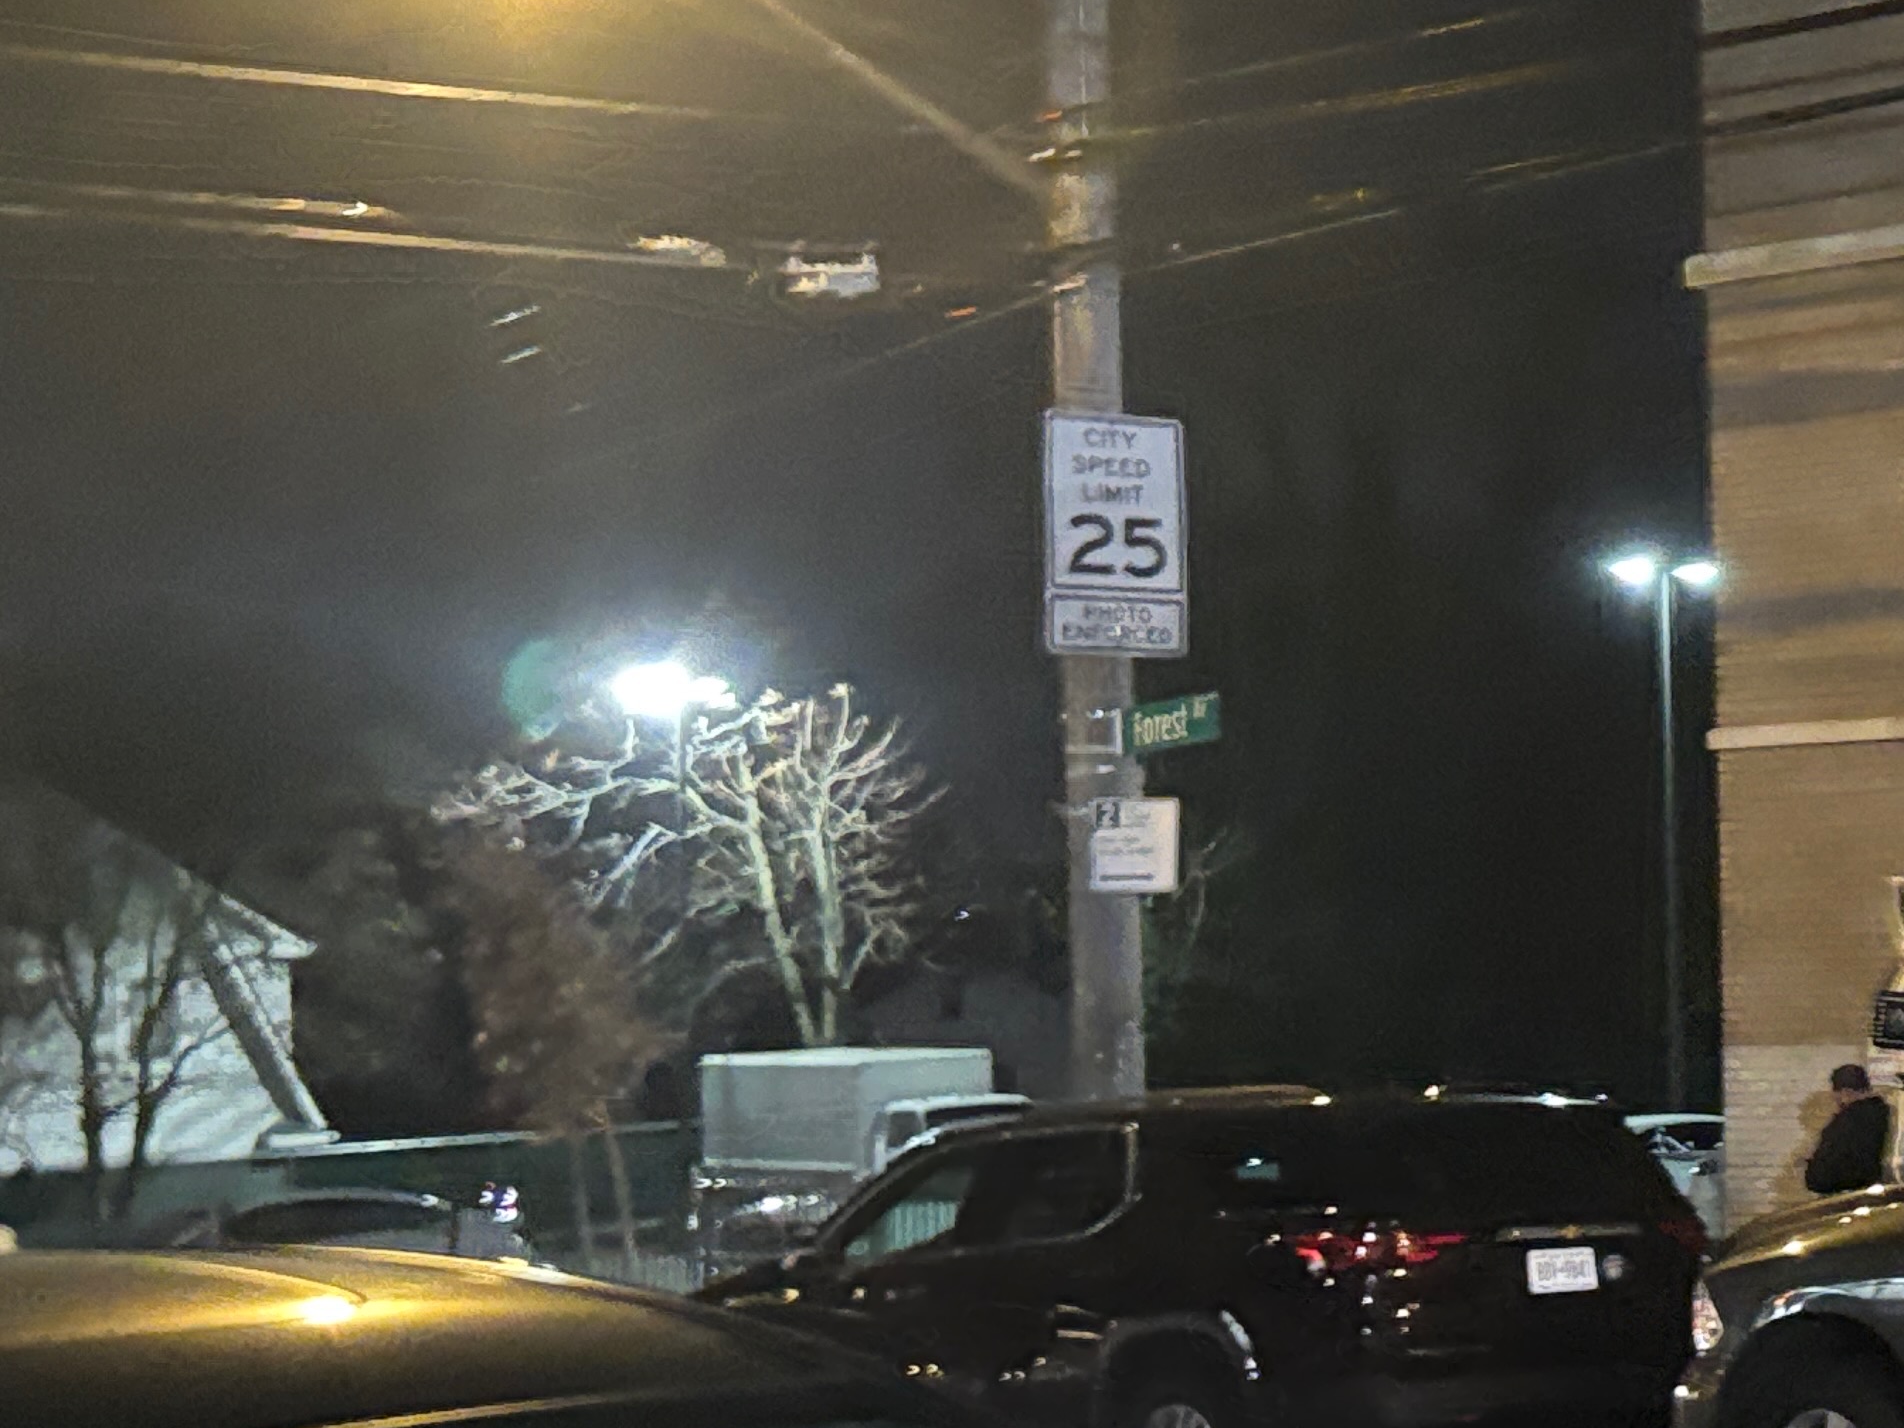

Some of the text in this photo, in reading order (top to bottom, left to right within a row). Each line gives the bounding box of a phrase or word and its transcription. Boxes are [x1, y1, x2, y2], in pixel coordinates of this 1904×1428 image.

[1083, 427, 1137, 448] CITY
[1070, 455, 1151, 477] SPEED
[1081, 482, 1143, 504] LIMIT
[1070, 513, 1167, 578] 25
[1082, 605, 1153, 623] PHOTO
